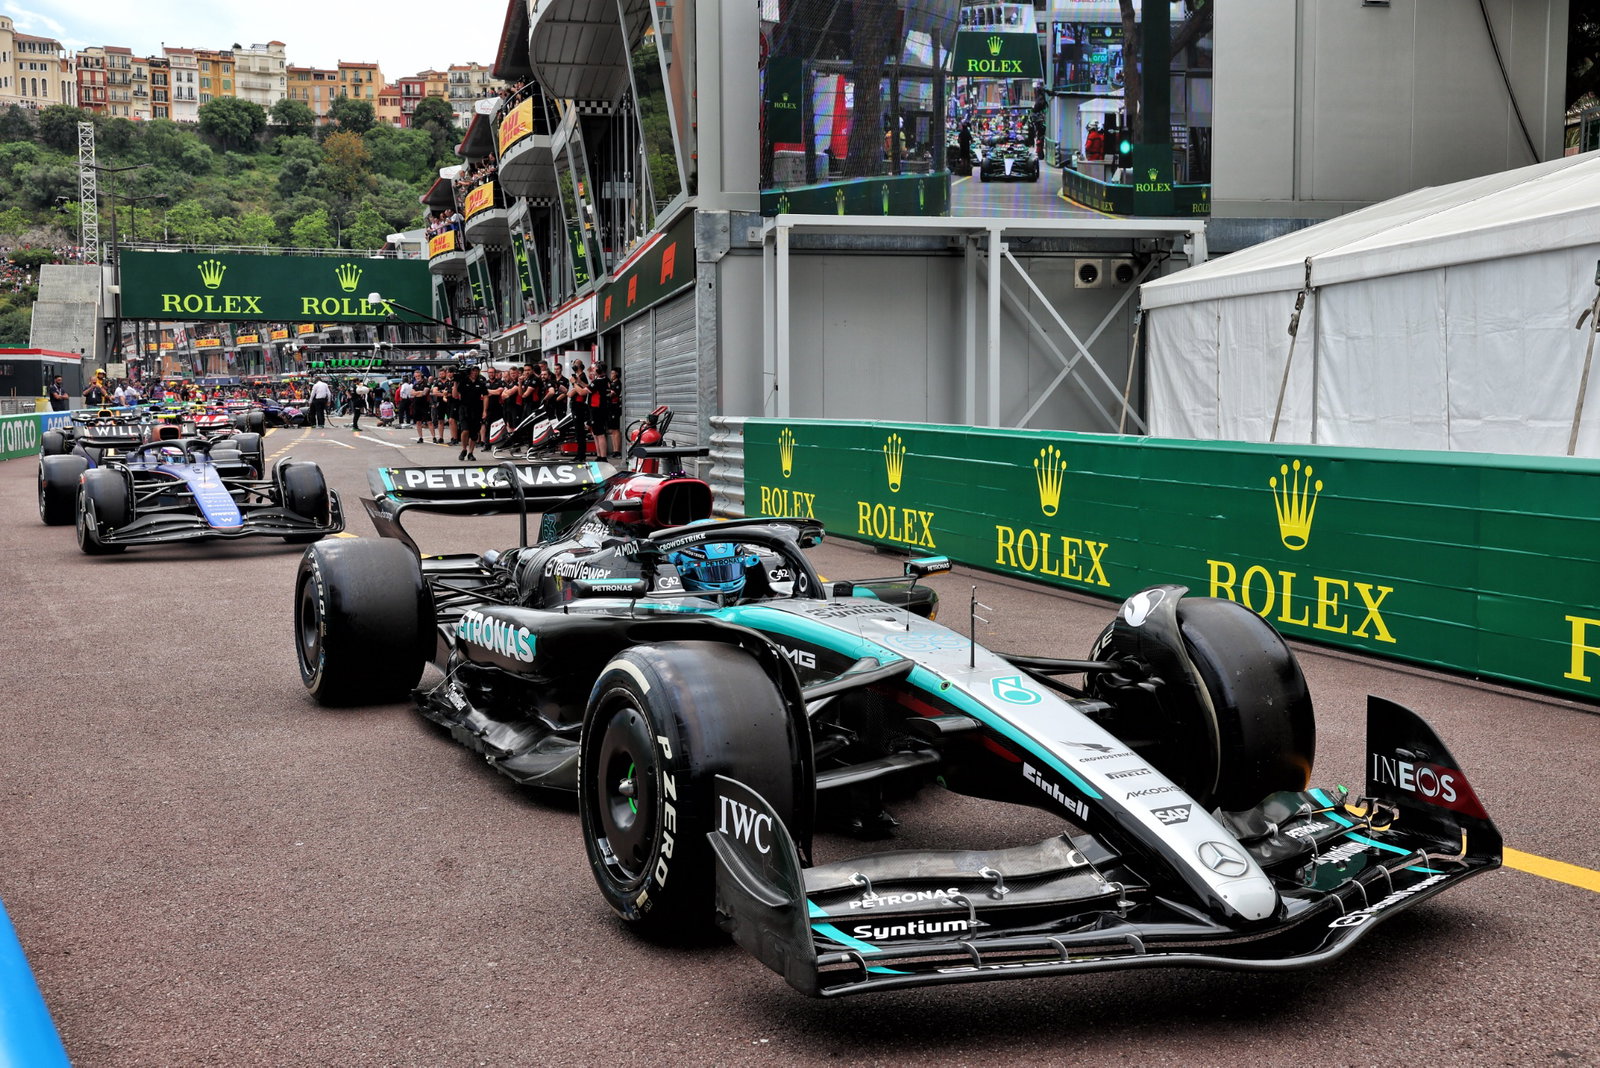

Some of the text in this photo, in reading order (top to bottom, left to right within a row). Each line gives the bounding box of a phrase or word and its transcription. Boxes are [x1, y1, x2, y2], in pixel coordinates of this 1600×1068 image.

[967, 59, 1023, 73] ROLEX
[1135, 183, 1172, 191] ROLEX
[161, 294, 264, 314] ROLEX
[301, 296, 396, 316] ROLEX
[0, 419, 36, 453] ramco
[404, 464, 577, 488] PETRONAS
[761, 485, 816, 519] ROLEX
[857, 501, 936, 549] ROLEX
[614, 542, 636, 558] AMD
[659, 532, 707, 551] CROWDSTRIKE
[995, 525, 1111, 588] ROLEX
[552, 561, 611, 580] TeamViewer
[768, 568, 790, 582] G42
[658, 576, 680, 589] G42
[1206, 559, 1397, 644] ROLEX
[813, 605, 902, 619] Syntium
[458, 609, 534, 663] ETRONAS
[1079, 751, 1135, 763] CROWDSTRIKE
[1105, 768, 1152, 780] PIRELLI
[1372, 752, 1457, 803] INEOS
[1022, 761, 1090, 822] Einhell
[1126, 784, 1185, 800] AKKODIS
[654, 735, 677, 888] P ZERO
[1154, 808, 1190, 824] SAP
[719, 795, 772, 854] IWC
[850, 887, 960, 910] PETRONAS
[853, 919, 968, 940] Syntium
